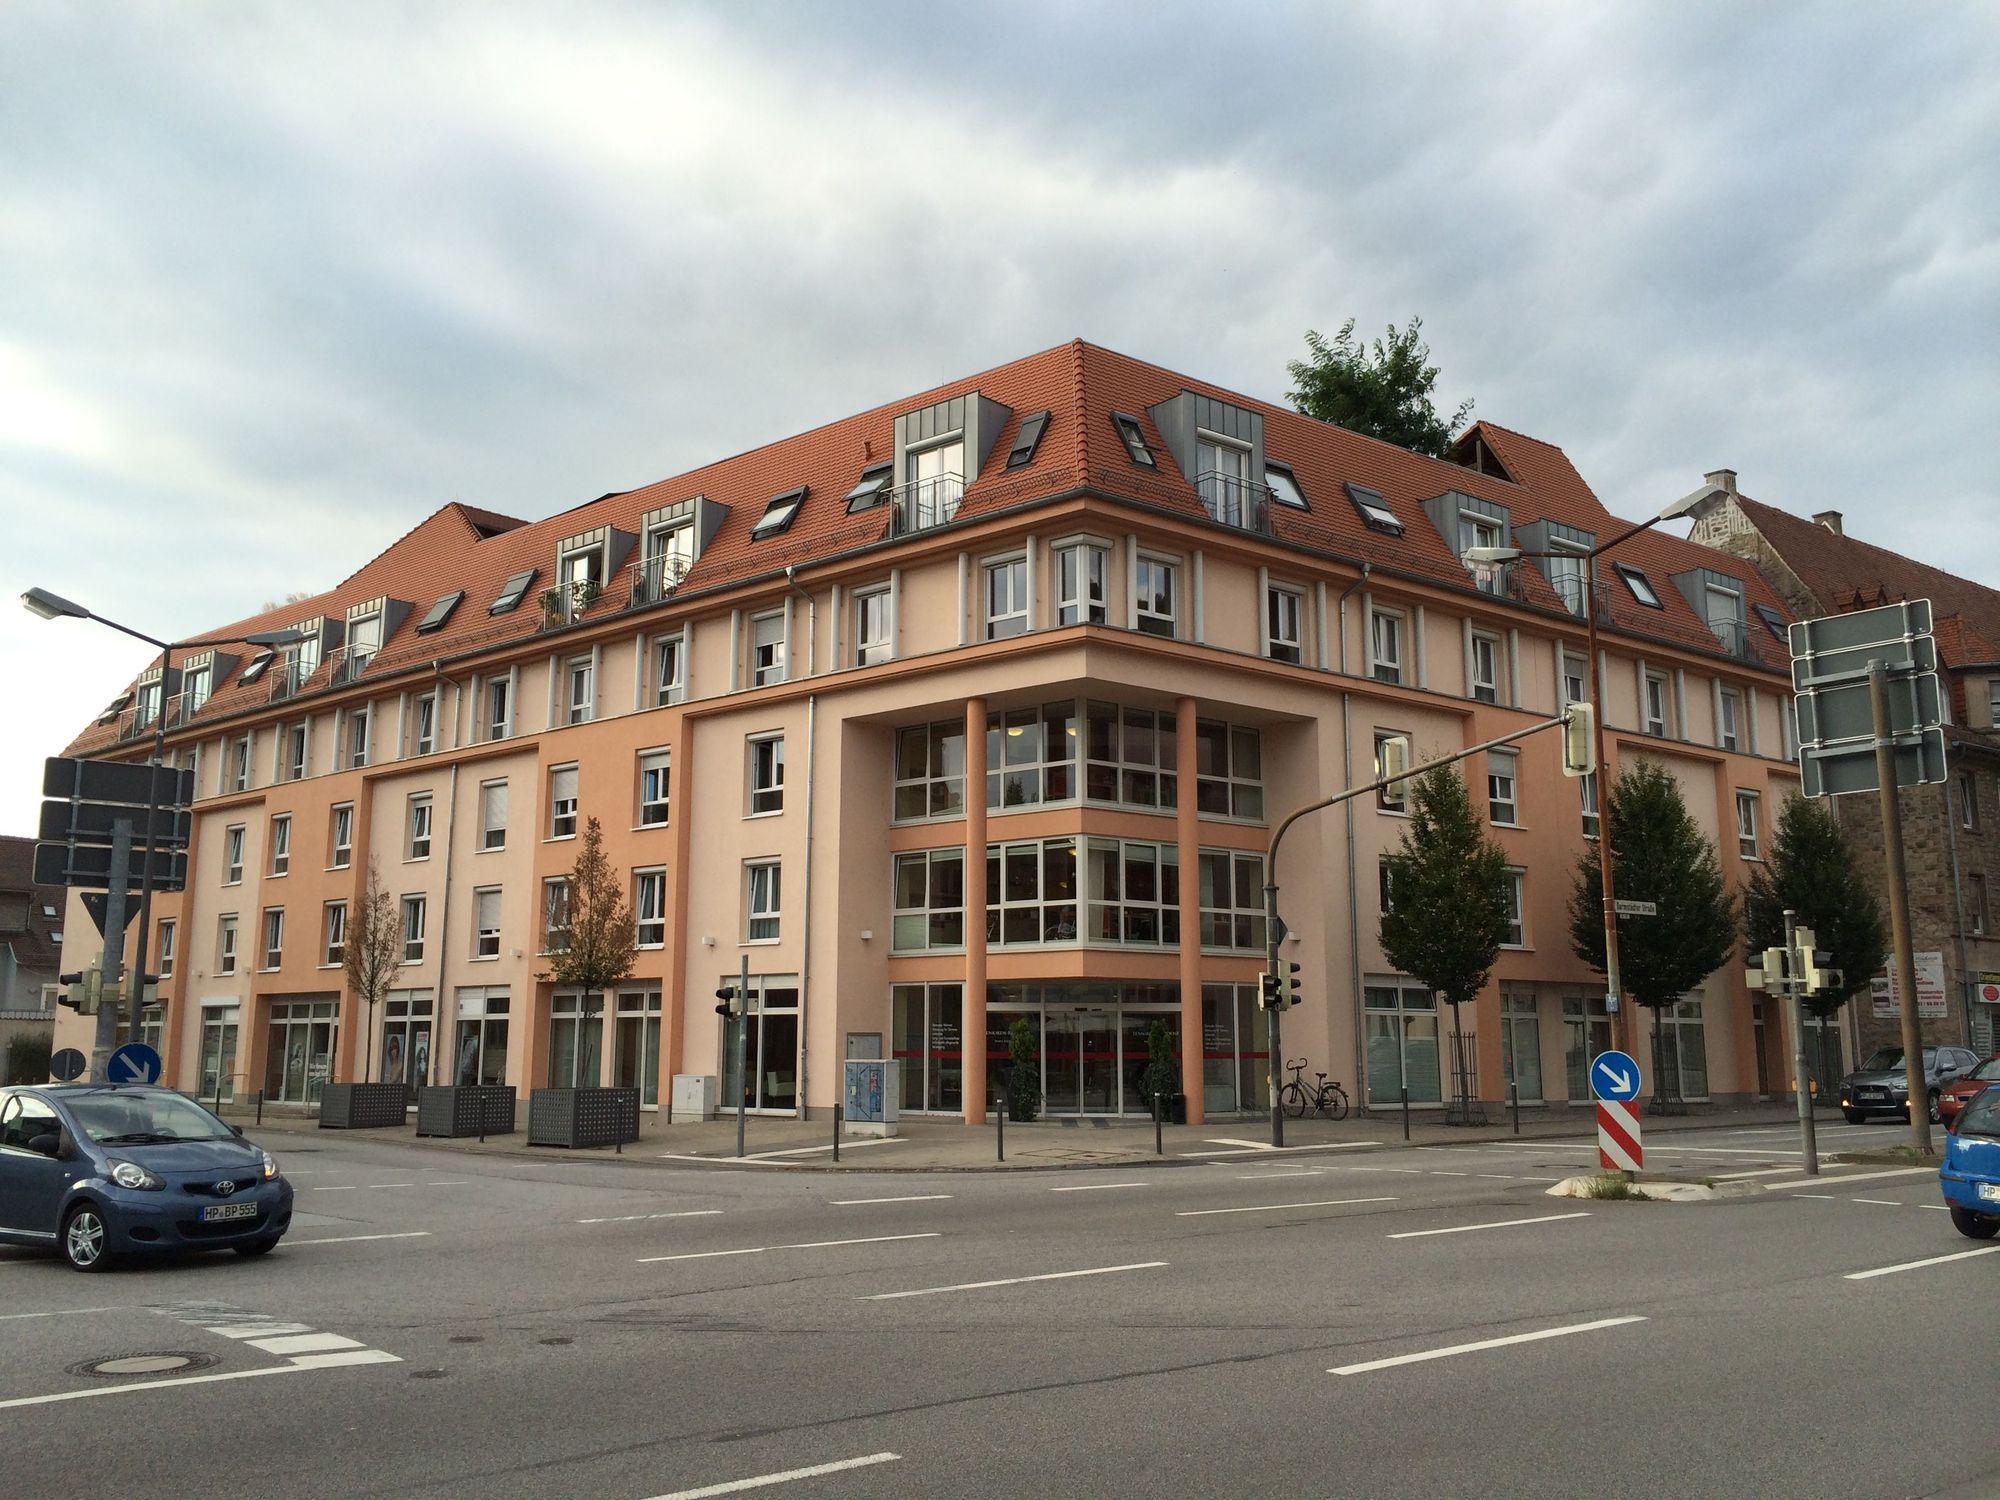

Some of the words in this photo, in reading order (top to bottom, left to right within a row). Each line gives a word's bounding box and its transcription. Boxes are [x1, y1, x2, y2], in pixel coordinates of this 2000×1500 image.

[1983, 1187, 1996, 1197] HP
[205, 1208, 219, 1219] HP
[225, 1206, 238, 1217] BP
[239, 1204, 256, 1216] 555
